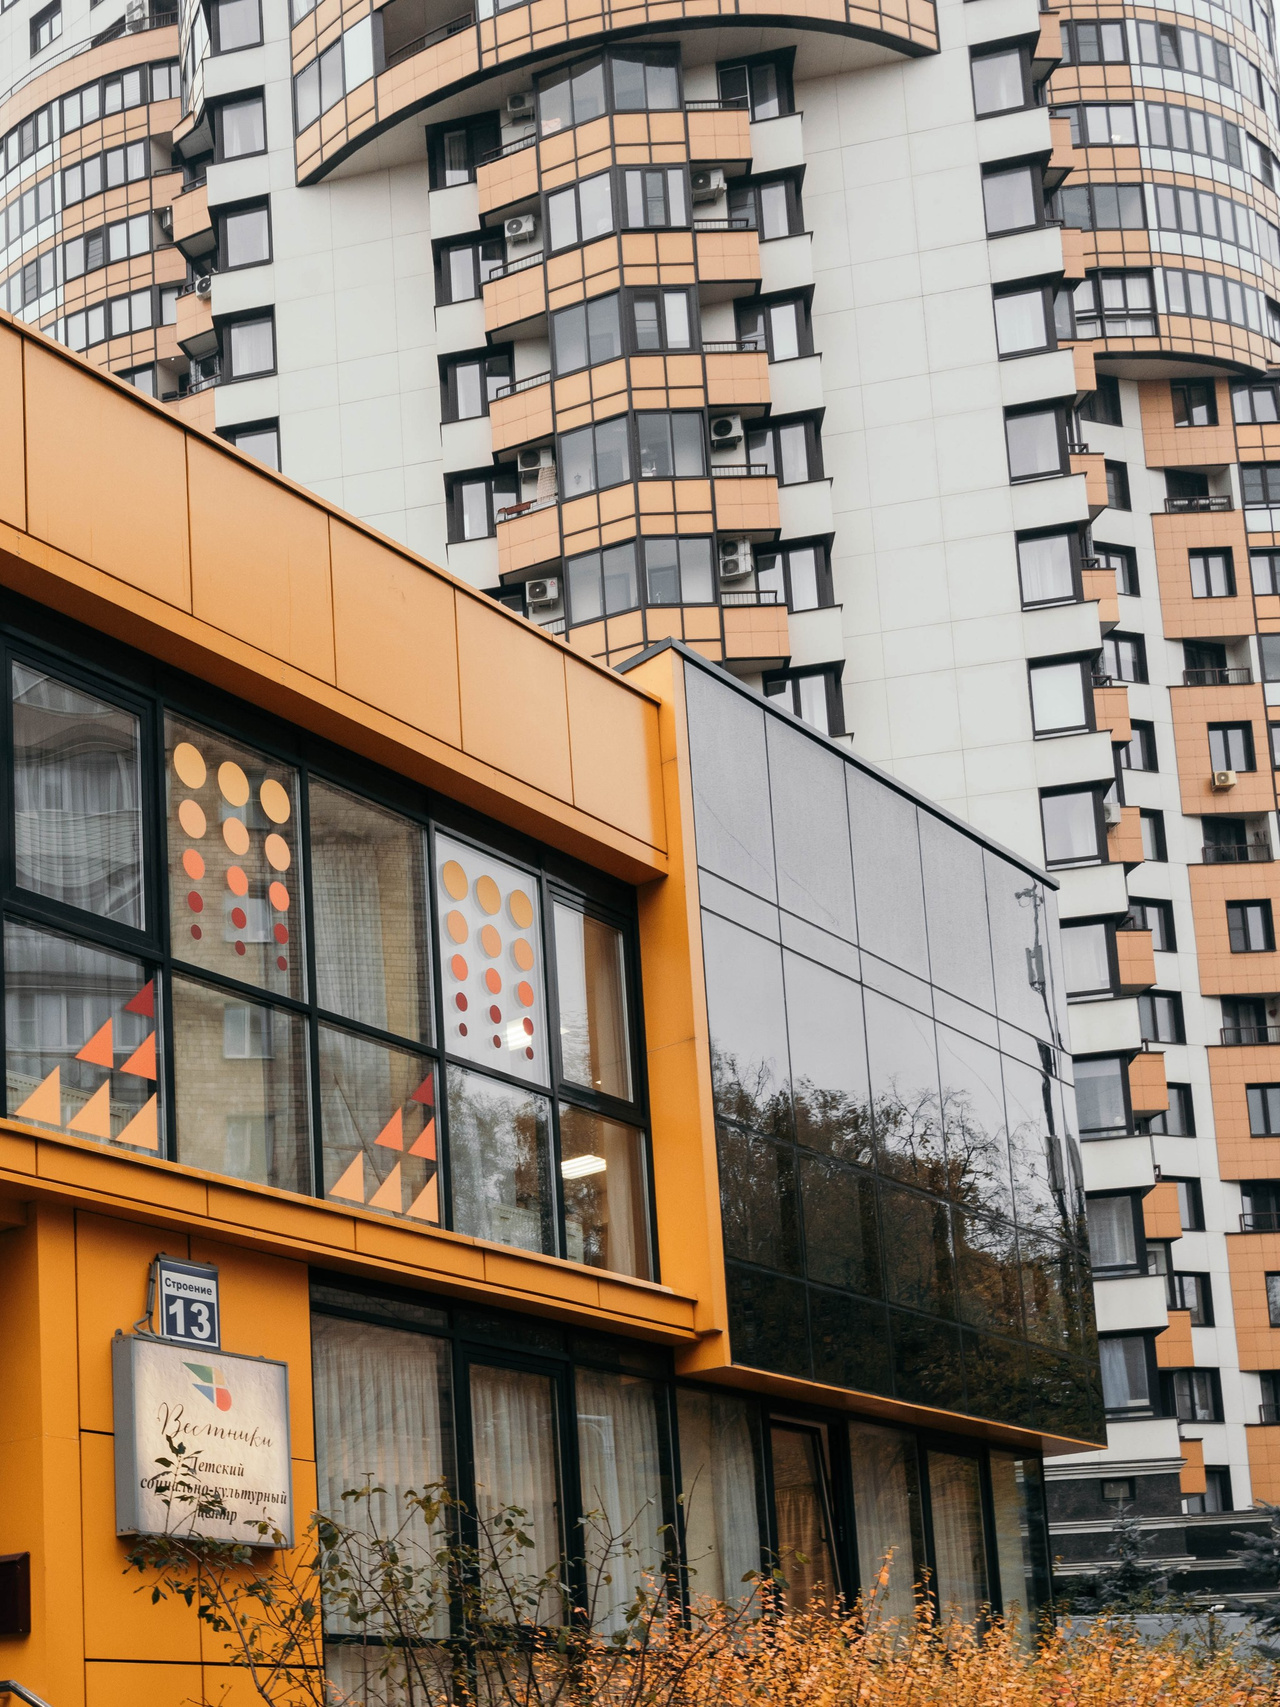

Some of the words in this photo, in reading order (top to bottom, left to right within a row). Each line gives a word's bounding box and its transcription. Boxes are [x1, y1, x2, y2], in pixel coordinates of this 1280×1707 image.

[164, 1277, 213, 1296] Строение
[168, 1298, 211, 1340] 13
[157, 1402, 273, 1447] Вестники
